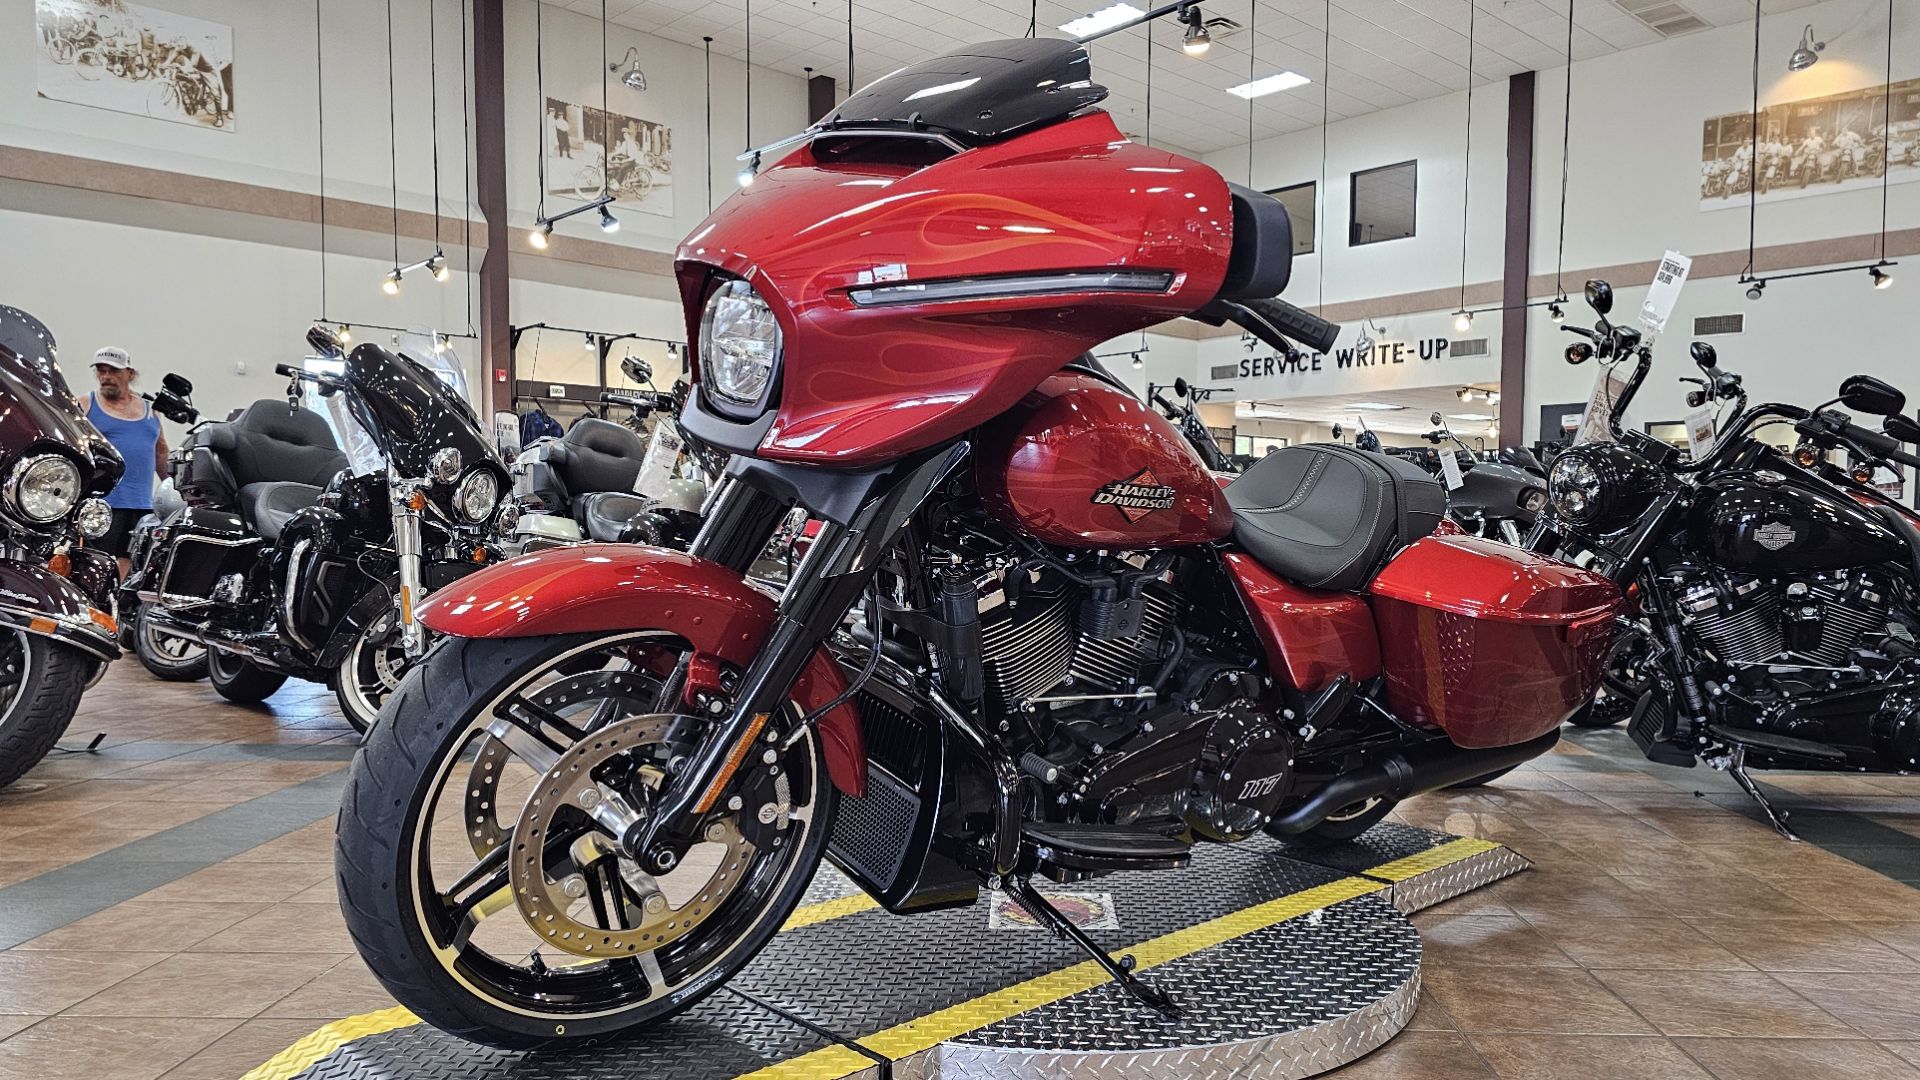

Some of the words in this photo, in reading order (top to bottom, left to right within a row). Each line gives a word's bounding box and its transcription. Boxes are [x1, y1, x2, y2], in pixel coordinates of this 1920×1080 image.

[1239, 352, 1322, 378] SERVICE
[1336, 338, 1449, 369] WRITE-UP
[1238, 772, 1283, 800] 117
